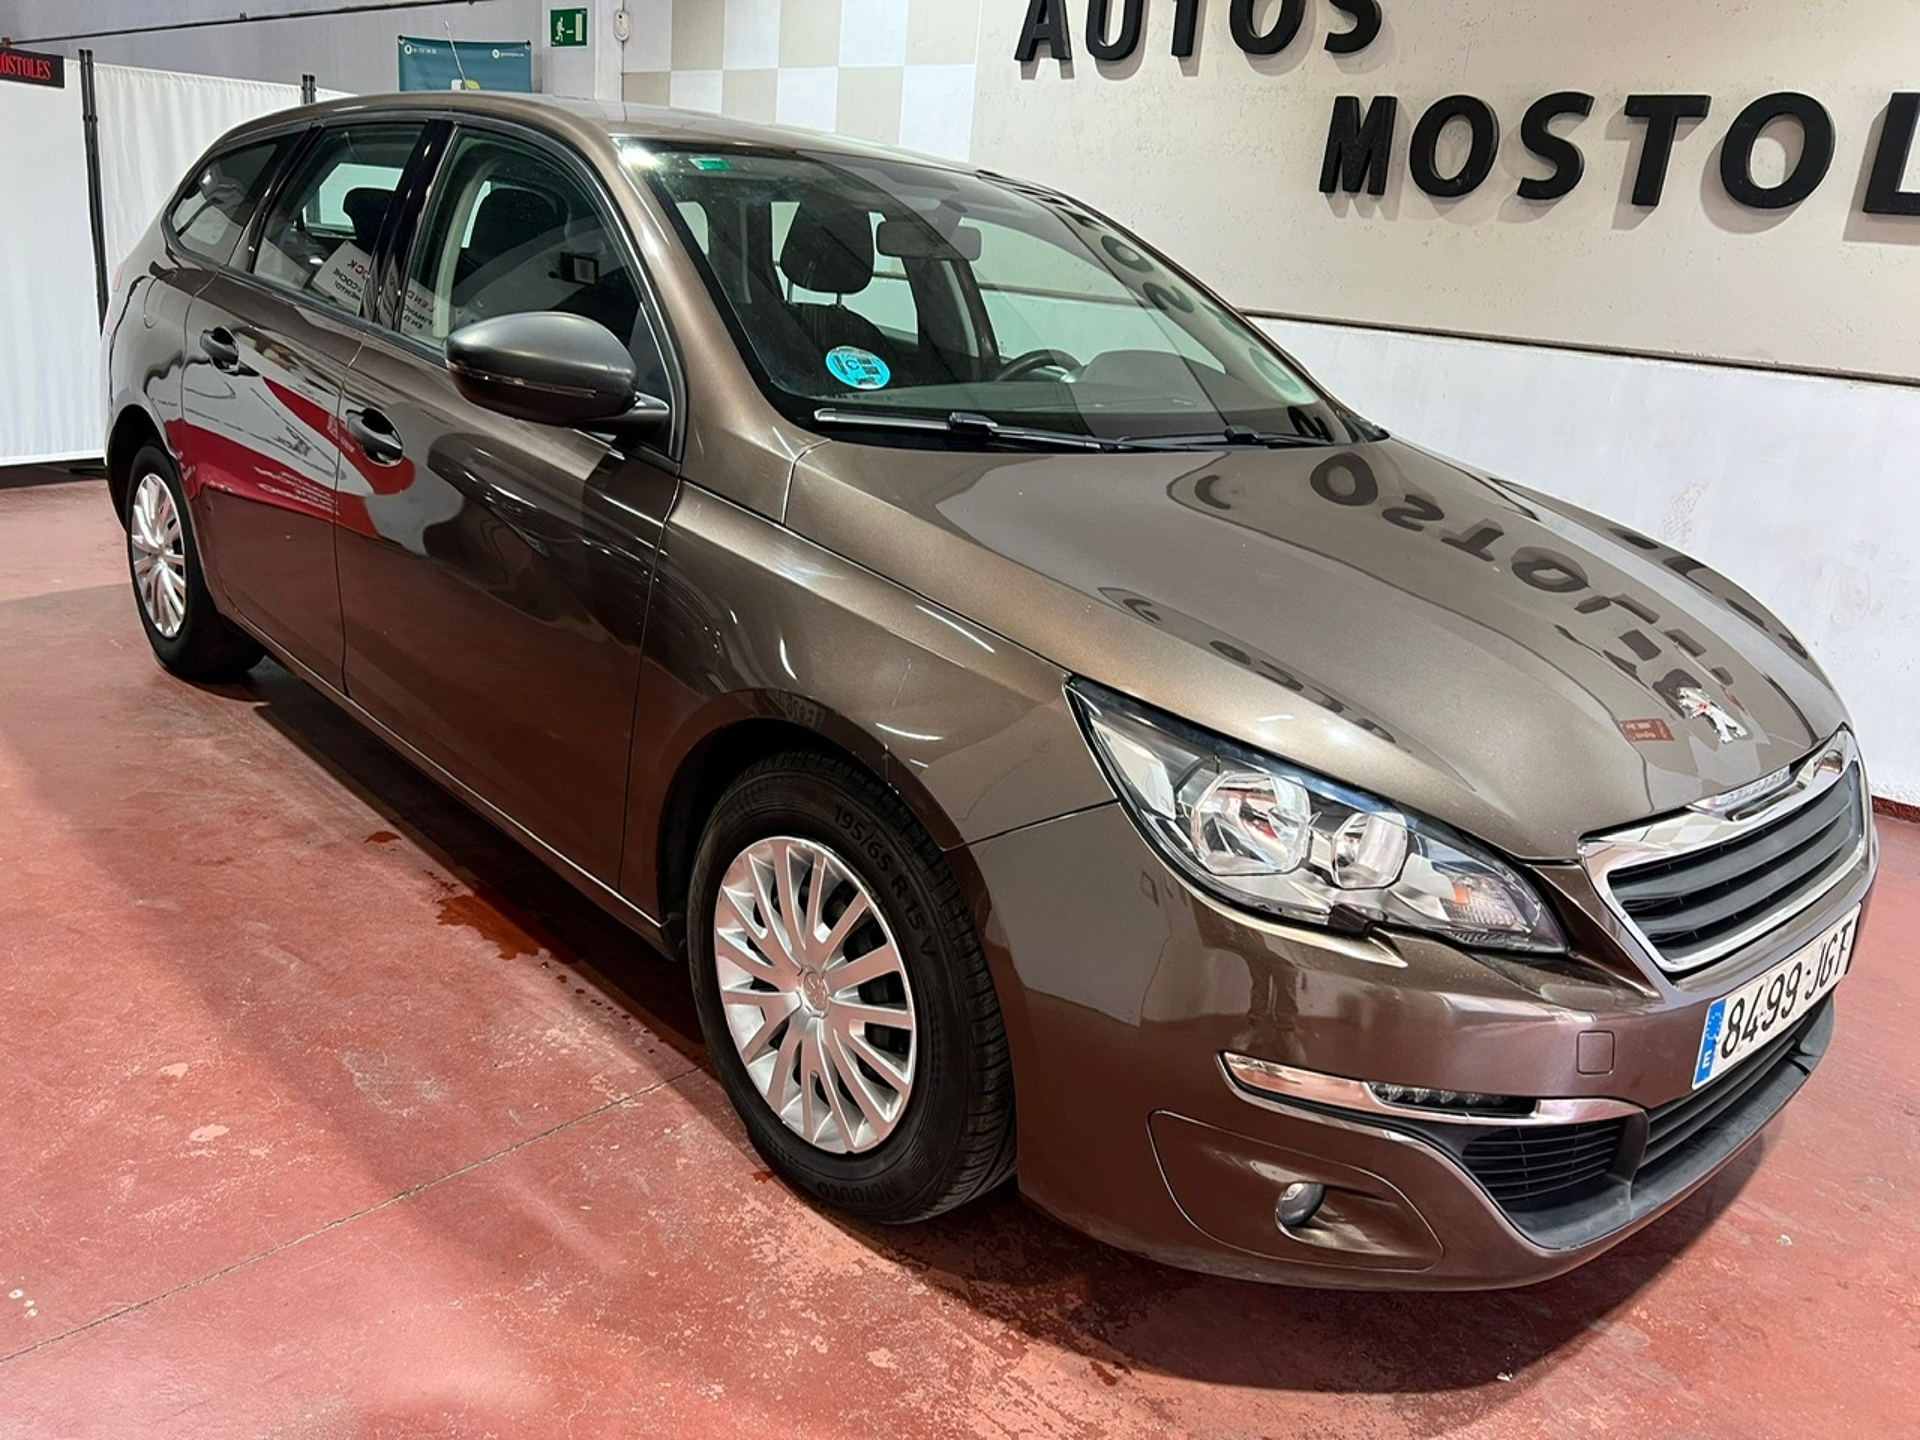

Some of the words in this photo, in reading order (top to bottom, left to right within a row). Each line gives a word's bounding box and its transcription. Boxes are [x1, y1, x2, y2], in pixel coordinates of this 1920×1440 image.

[0, 51, 52, 81] ÓSTOLES
[834, 805, 893, 872] 195/65
[890, 873, 907, 900] R
[1721, 960, 1803, 1060] 8499
